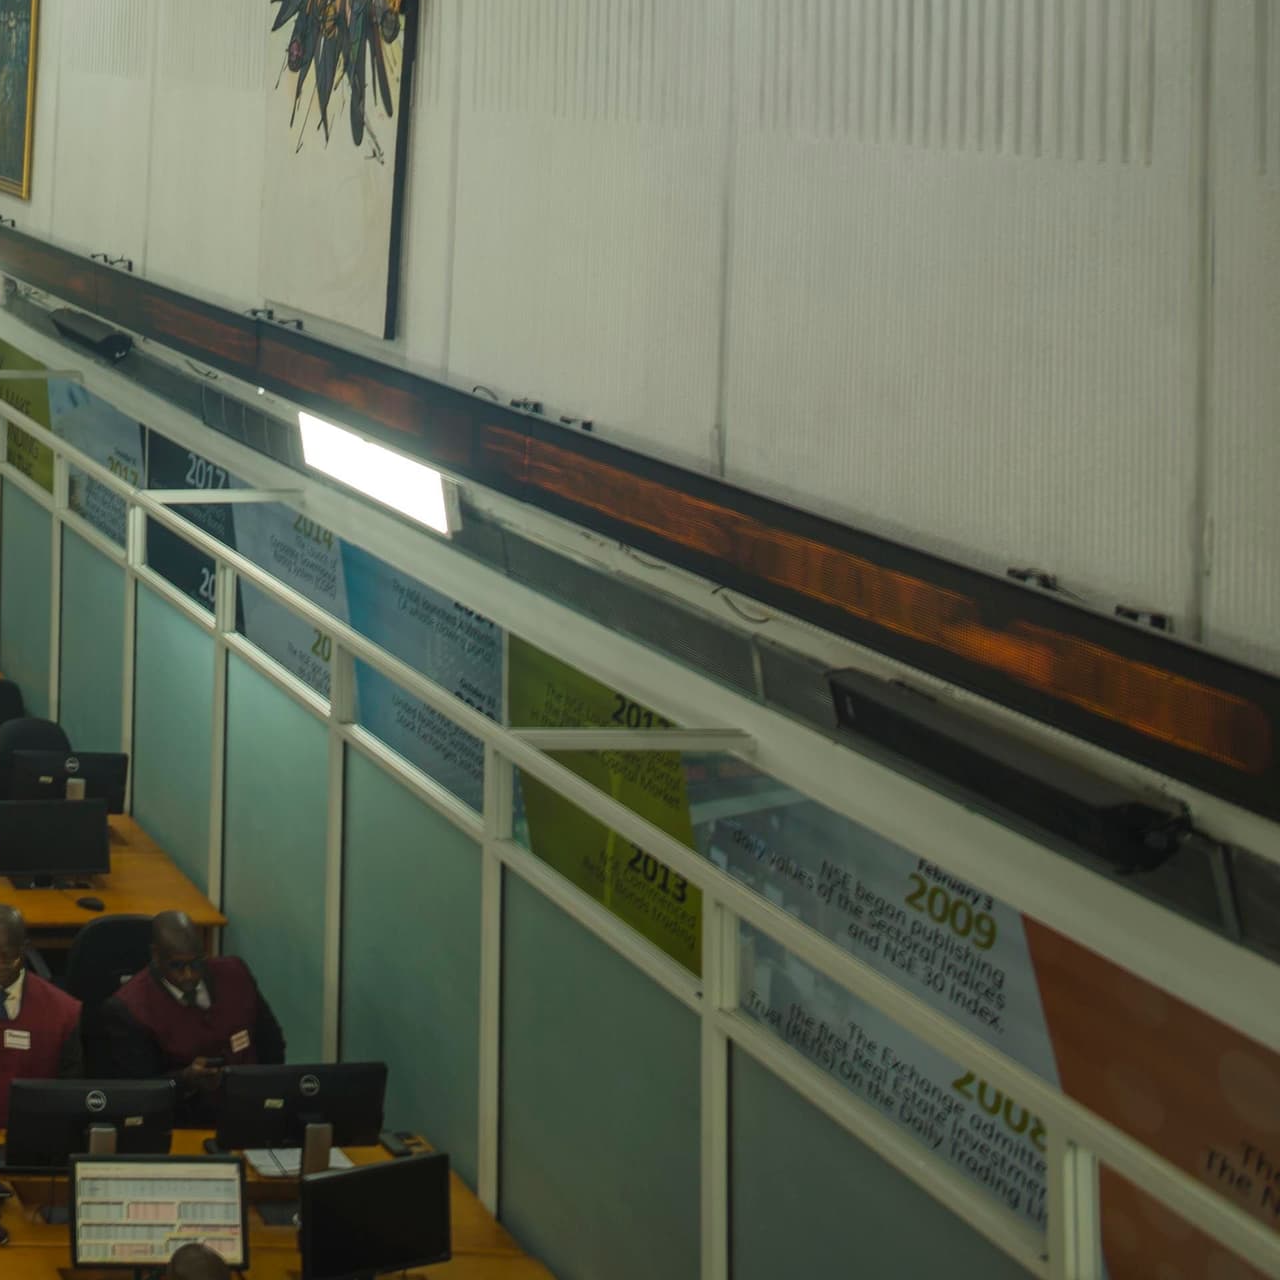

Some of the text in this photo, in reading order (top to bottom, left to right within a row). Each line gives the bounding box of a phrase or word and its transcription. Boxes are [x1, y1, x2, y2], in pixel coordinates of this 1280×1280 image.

[185, 452, 227, 489] 2017
[200, 568, 216, 602] 20
[312, 628, 332, 662] 20
[628, 843, 688, 904] 2013
[917, 857, 981, 907] February
[819, 859, 1006, 989] NSE began publishing
[905, 872, 998, 950] 2009
[838, 889, 865, 918] the
[870, 907, 937, 966] Sectoral
[940, 954, 1006, 1011] Indices
[848, 921, 881, 952] and
[884, 942, 917, 976] NSE
[848, 1020, 1048, 1174] The Exchange admitte
[852, 1041, 889, 1084] Real
[892, 1068, 950, 1125] Estate
[867, 1075, 895, 1109] the
[898, 1099, 946, 1151] Daily
[949, 1133, 1023, 1212] Trading
